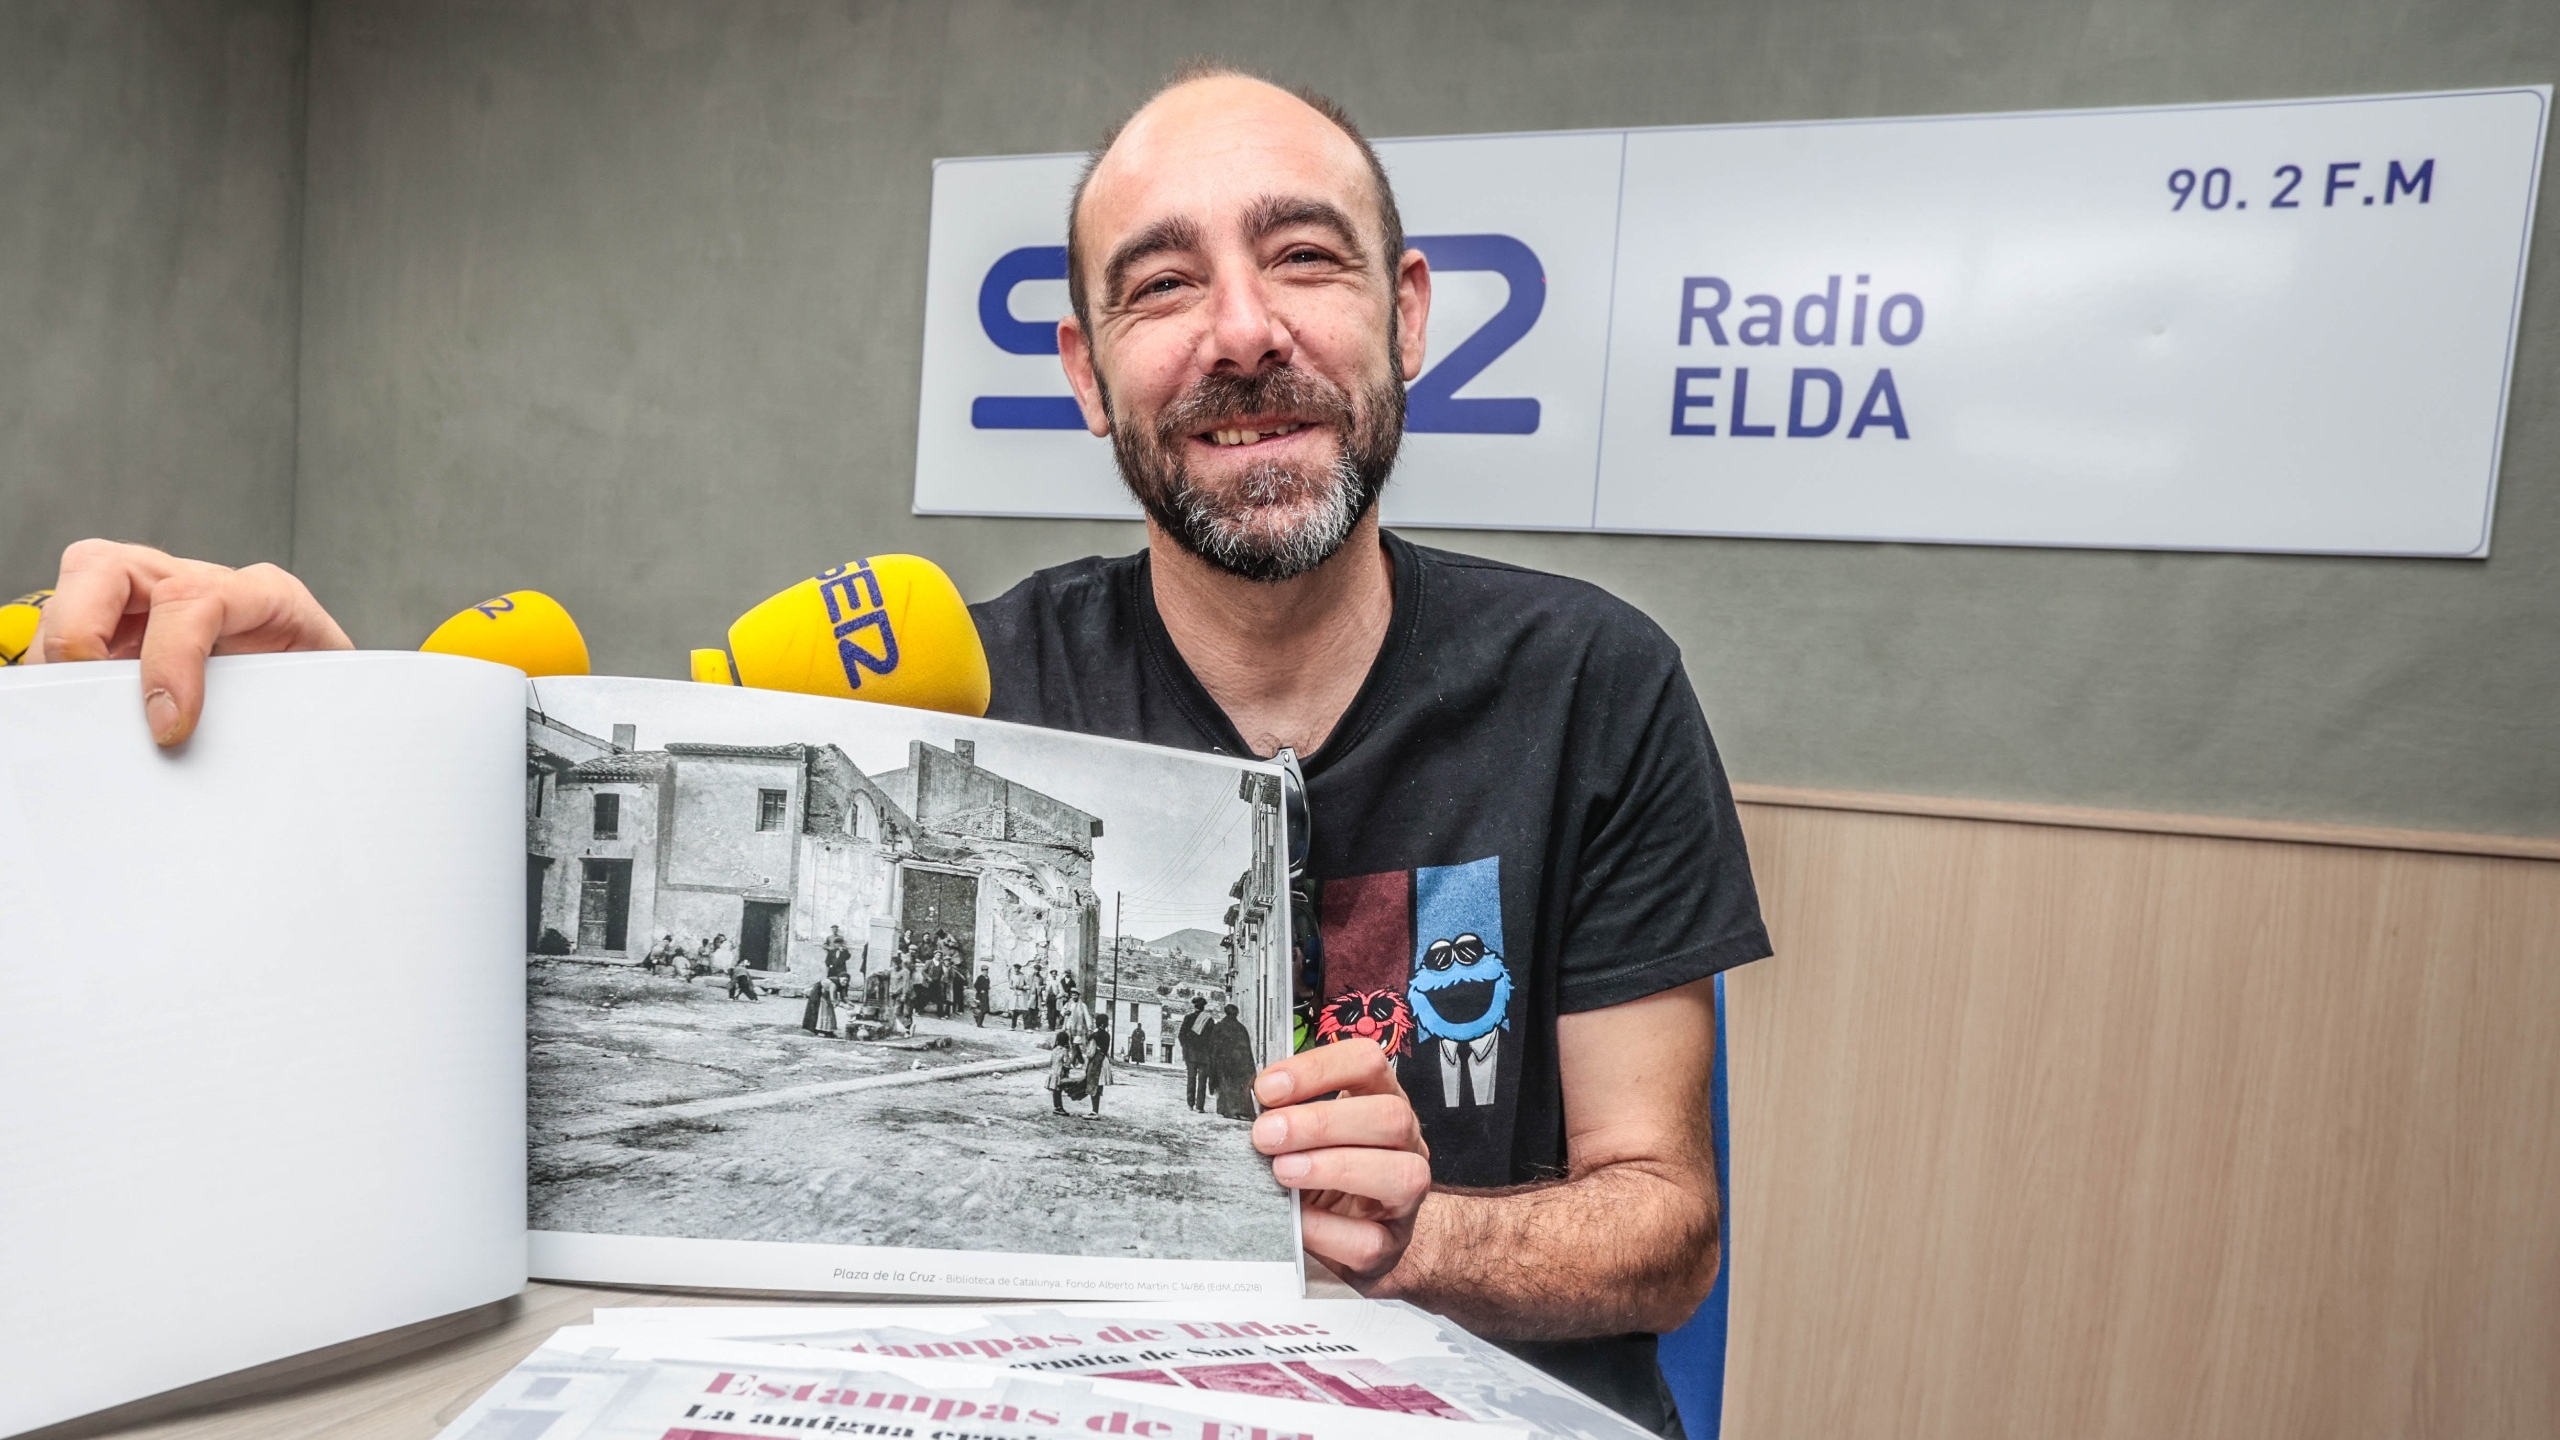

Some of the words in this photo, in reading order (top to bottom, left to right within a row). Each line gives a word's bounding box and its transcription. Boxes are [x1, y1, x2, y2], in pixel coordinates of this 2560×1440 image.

[2270, 164, 2303, 209] 2
[2323, 158, 2435, 208] F.M
[1678, 274, 1924, 346] Radio
[1670, 367, 1910, 440] ELDA
[833, 1268, 869, 1281] Plaza
[873, 1270, 889, 1281] de
[893, 1270, 905, 1282] la
[909, 1271, 935, 1283] Cruz
[946, 1274, 995, 1286] Biblioteca
[998, 1276, 1010, 1286] de
[1066, 1279, 1096, 1289] Fondo
[1099, 1280, 1134, 1290] Alberto
[1097, 1326, 1170, 1343] de
[1175, 1321, 1331, 1340] Elda:
[1139, 1350, 1179, 1361] de
[1186, 1347, 1256, 1358] San
[1263, 1341, 1360, 1355] Antón
[684, 1404, 736, 1421] La
[750, 1414, 915, 1438] antigua
[704, 1372, 1060, 1426] Estampas
[1086, 1411, 1172, 1438] de
